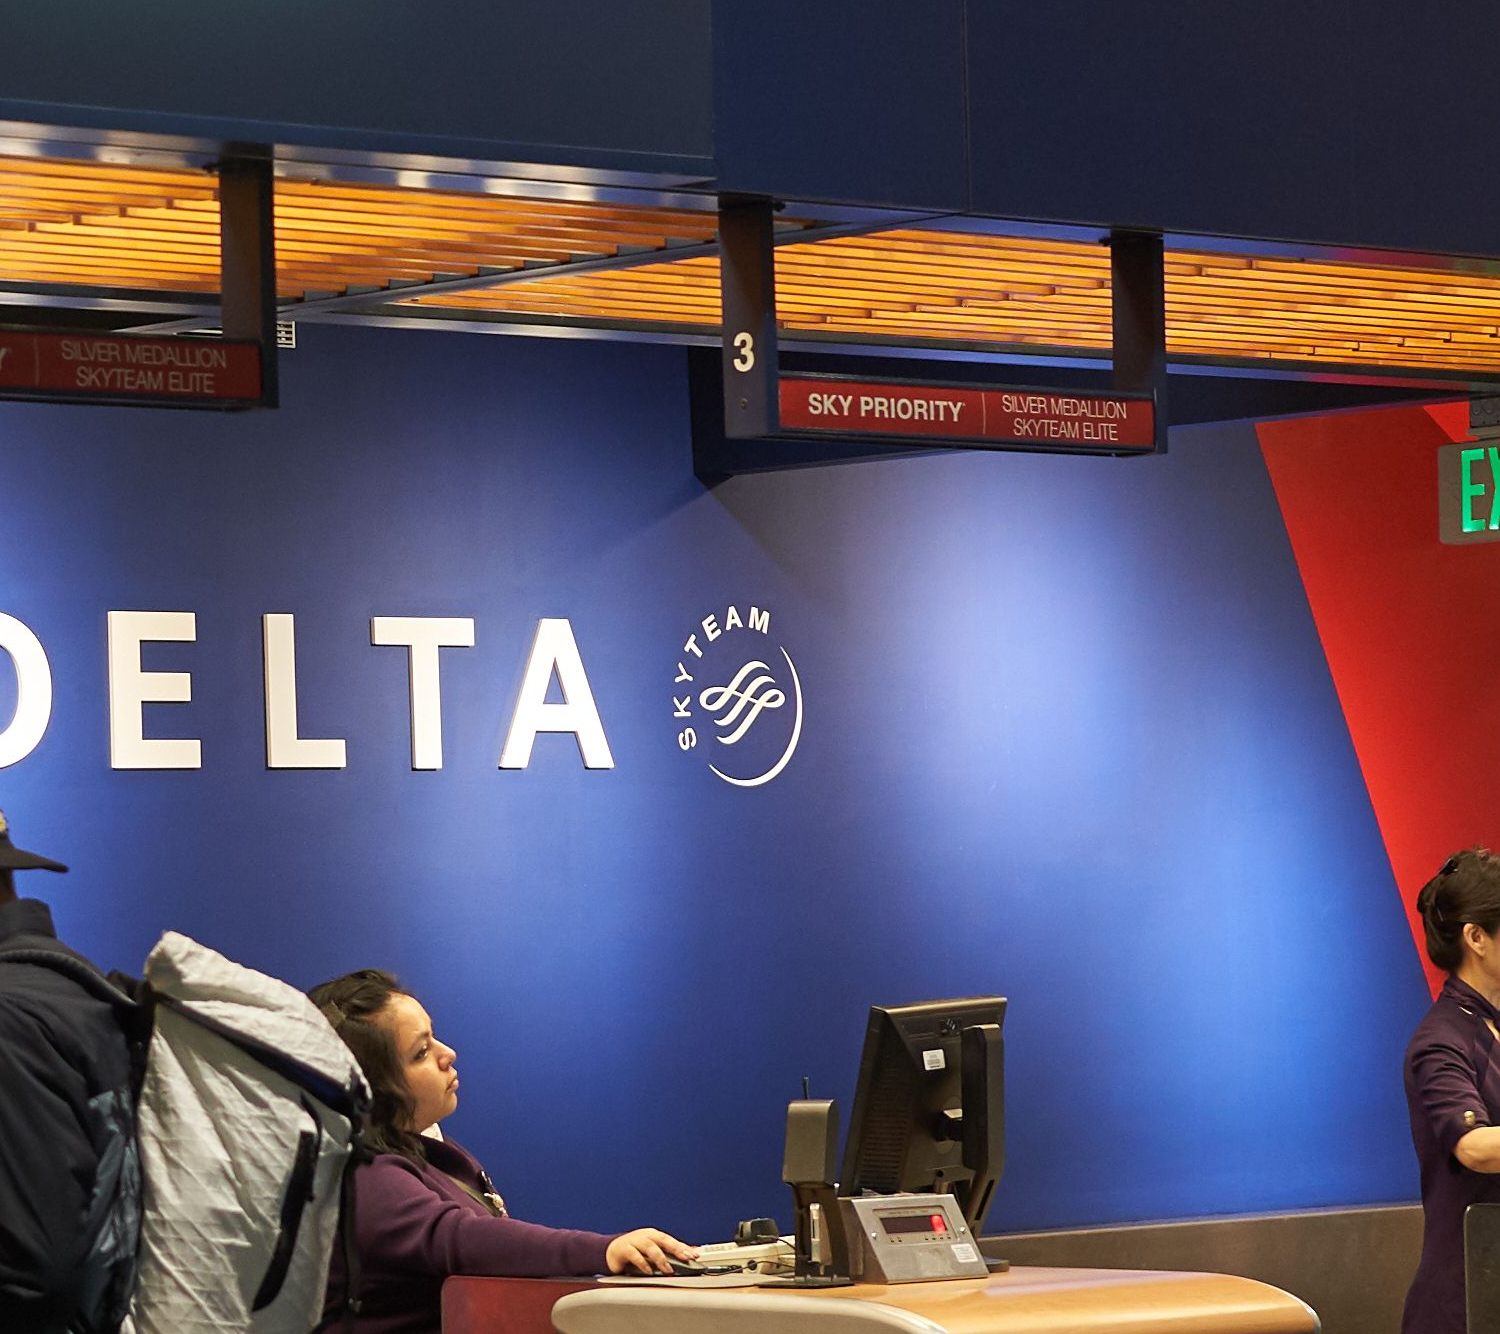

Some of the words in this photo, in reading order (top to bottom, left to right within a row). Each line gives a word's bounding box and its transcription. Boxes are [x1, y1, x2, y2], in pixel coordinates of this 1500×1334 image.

[61, 339, 123, 363] SILVER
[125, 342, 227, 369] MEDALLION
[733, 332, 754, 373] 3
[76, 366, 163, 391] SKYTEAM
[169, 372, 215, 393] ELITE
[808, 393, 853, 416] SKY
[860, 396, 962, 422] PRIORITY
[1002, 394, 1048, 415] SILVER
[1050, 398, 1128, 420] MEDALLION
[1013, 417, 1080, 439] SKYTEAM
[1084, 421, 1119, 441] ELITE
[672, 605, 771, 751] SKYTEAM
